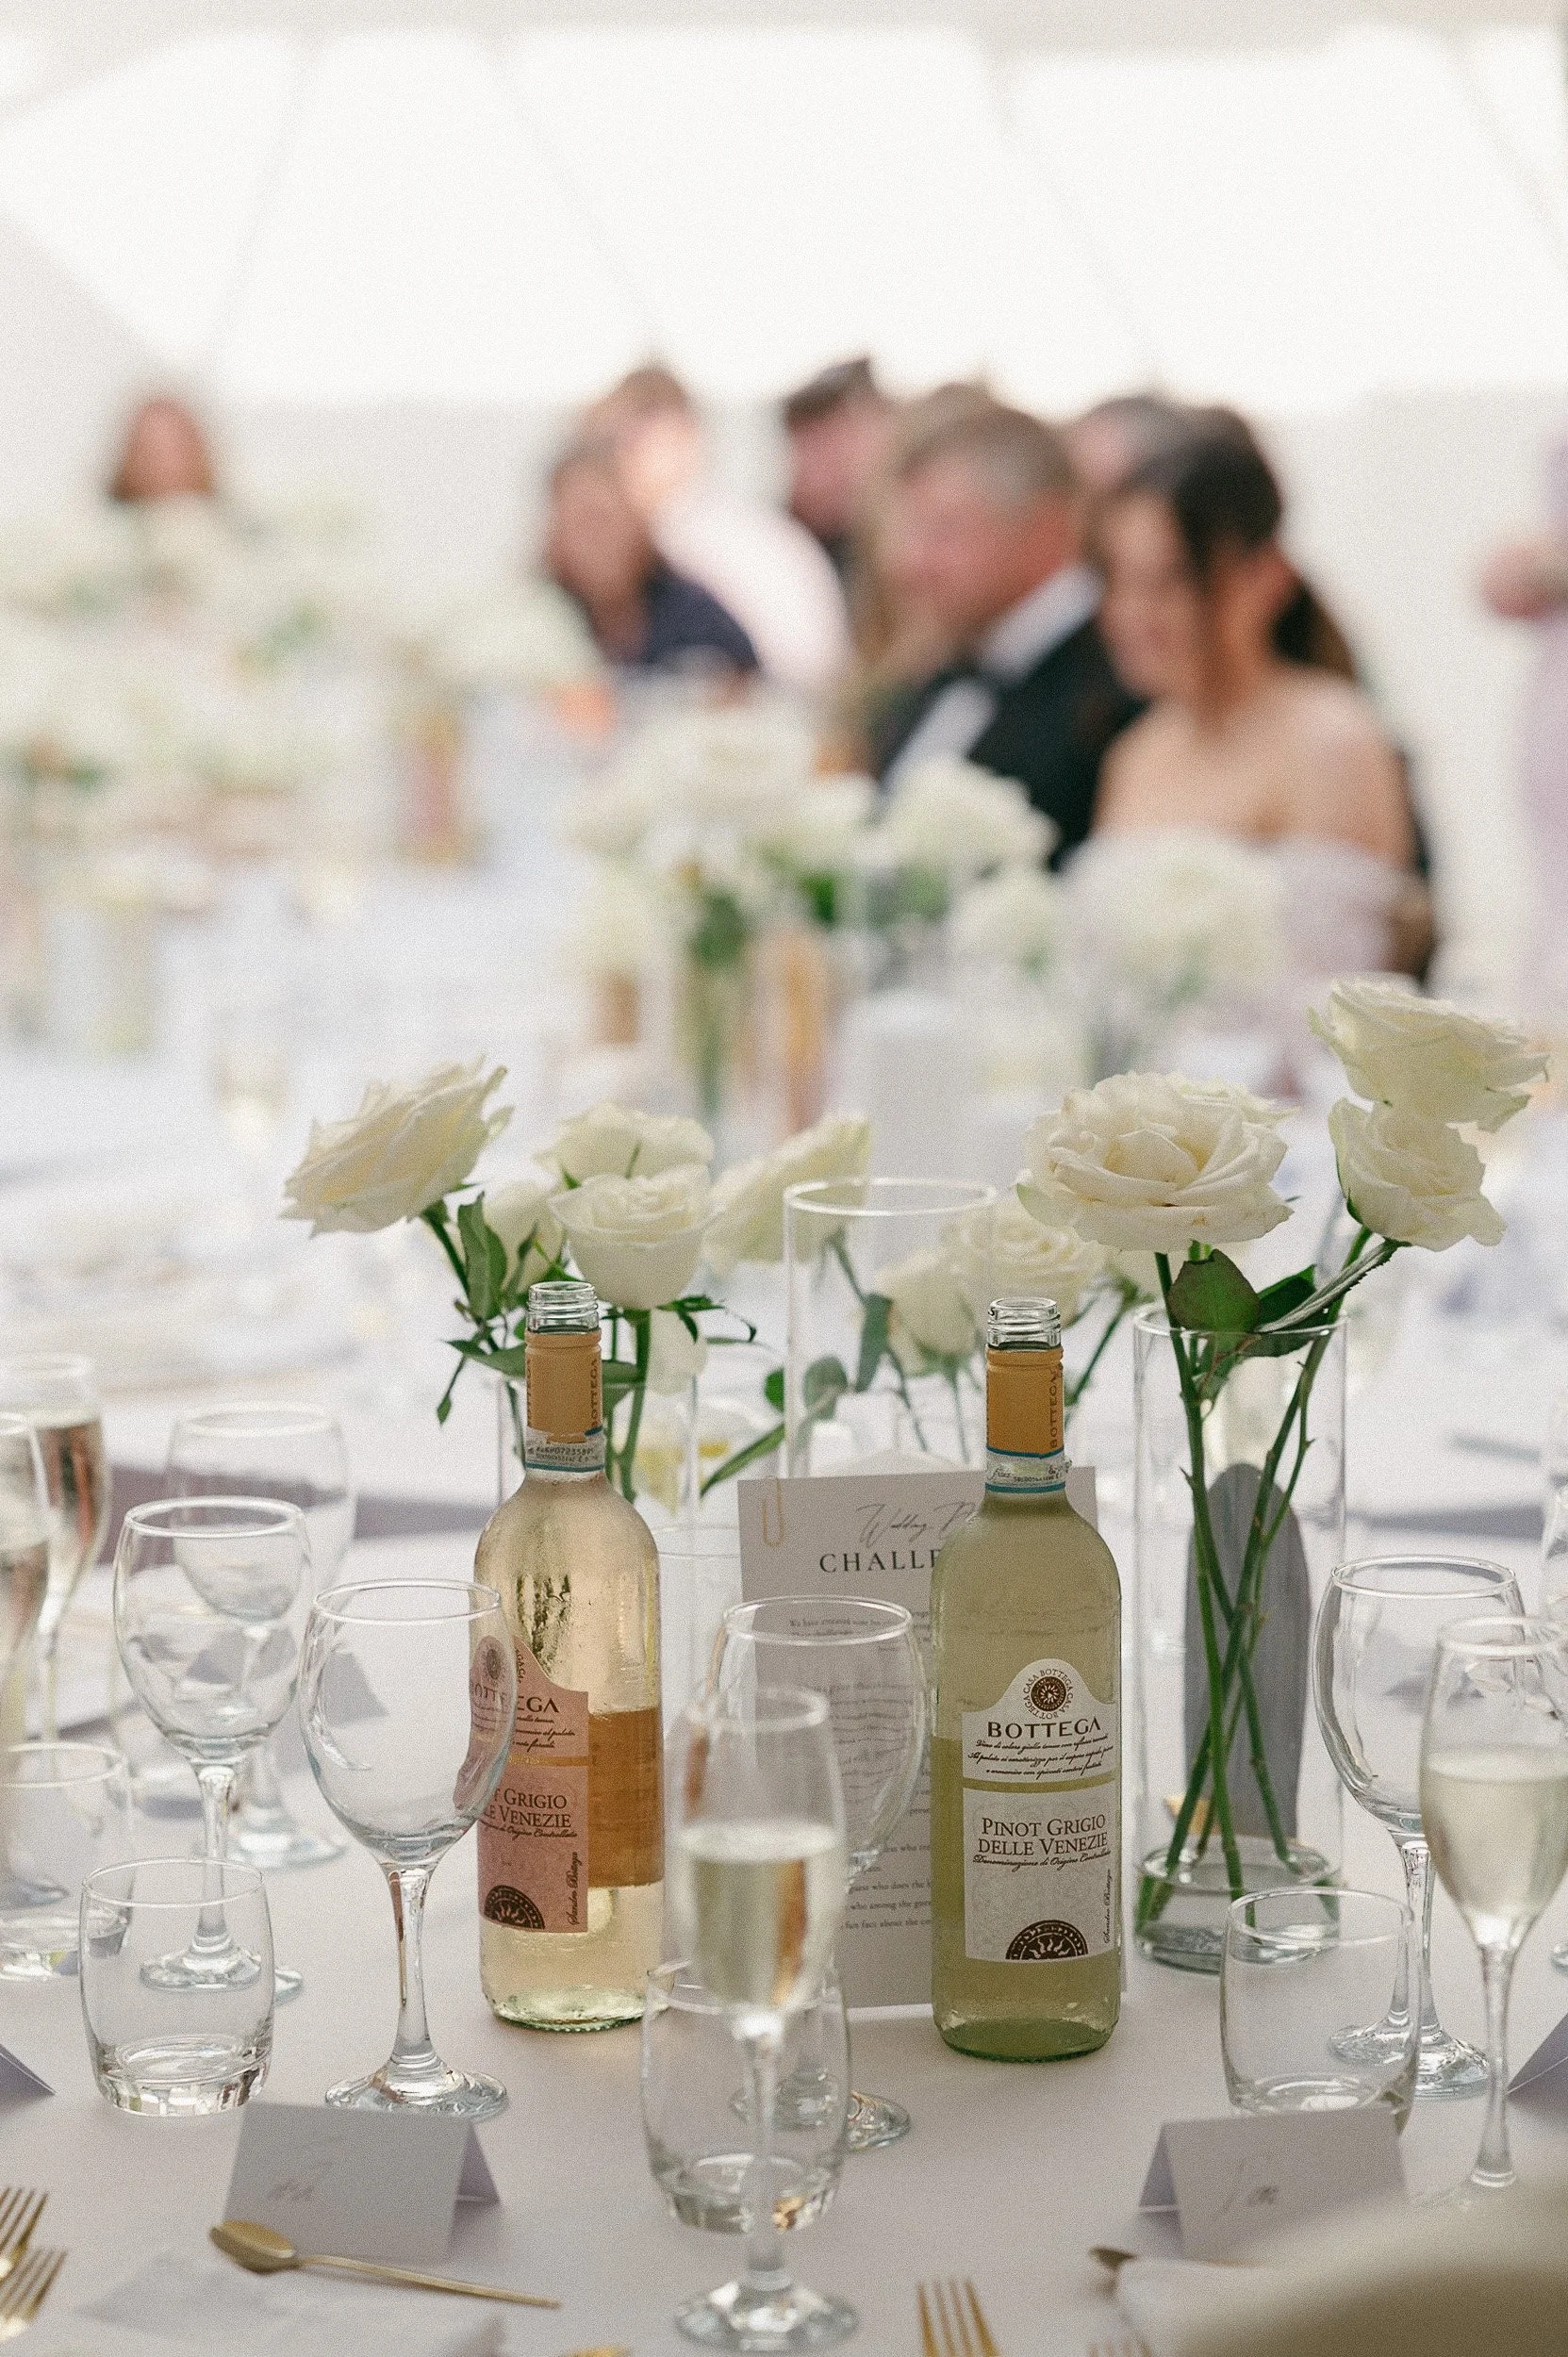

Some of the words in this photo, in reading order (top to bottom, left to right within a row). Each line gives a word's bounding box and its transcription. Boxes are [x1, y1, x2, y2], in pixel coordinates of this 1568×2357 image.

[819, 1548, 942, 1574] CHALLE
[1023, 1674, 1039, 1694] CASA
[1040, 1668, 1074, 1691] BOTTEGA
[987, 1716, 1101, 1739] BOTTEGA
[503, 1788, 568, 1809] GRIGIO
[500, 1805, 571, 1828] VENEZIE
[982, 1817, 1042, 1838] PINOT
[1047, 1814, 1106, 1837] GRIGIO
[978, 1838, 1035, 1856] DELLE
[1039, 1832, 1108, 1855] VENEZIE
